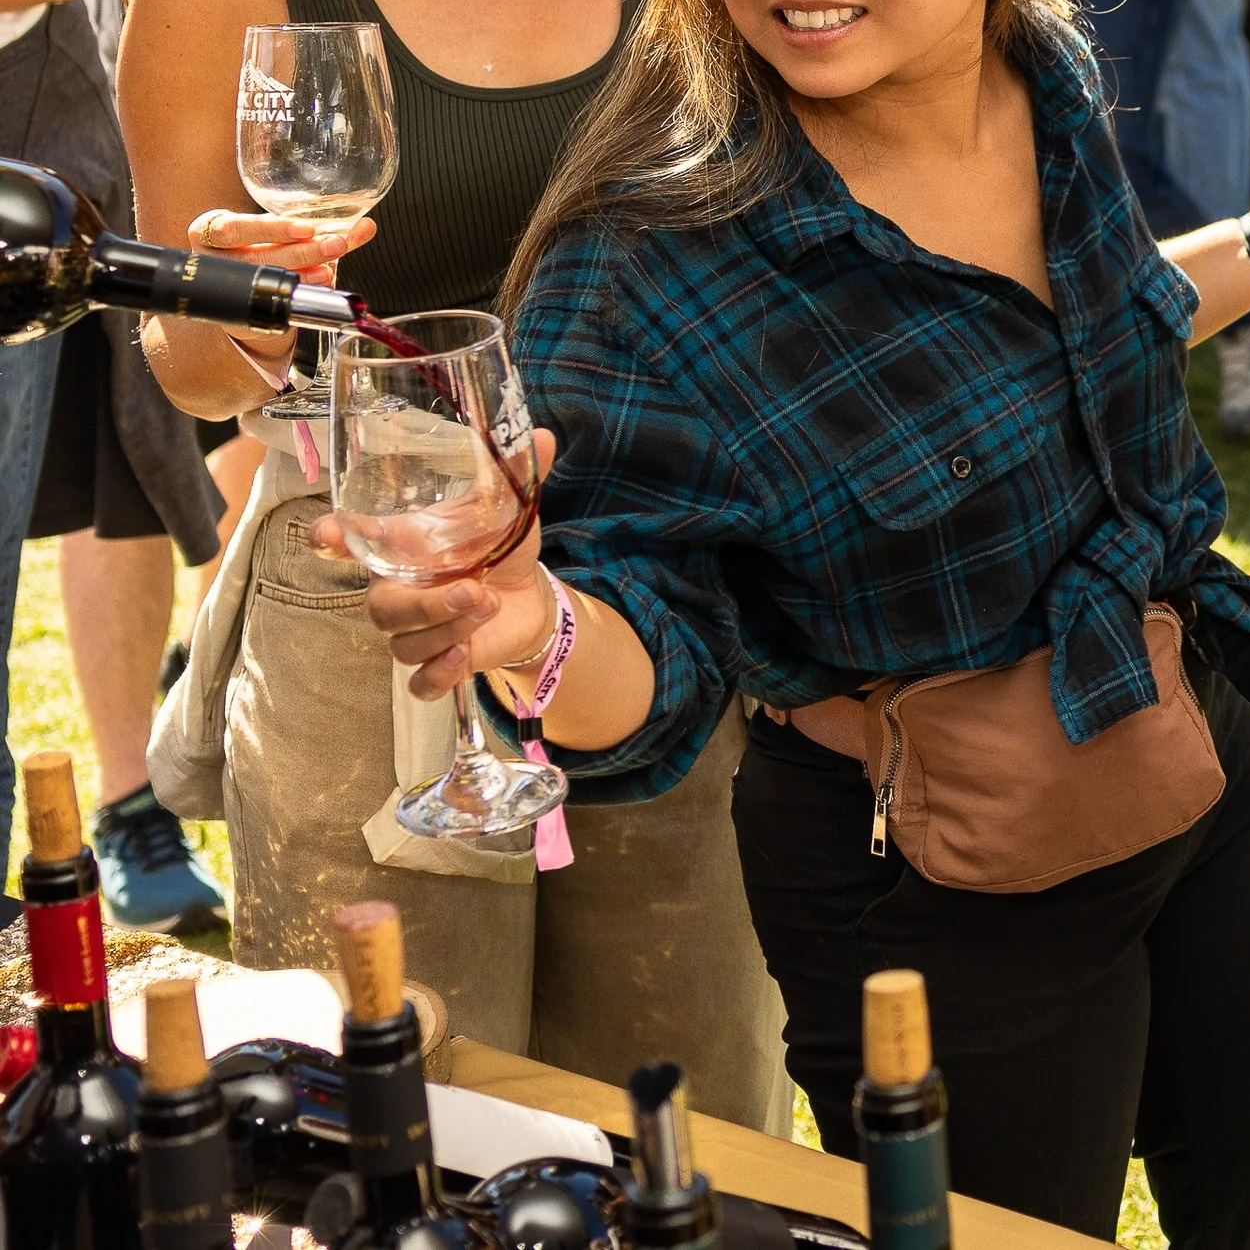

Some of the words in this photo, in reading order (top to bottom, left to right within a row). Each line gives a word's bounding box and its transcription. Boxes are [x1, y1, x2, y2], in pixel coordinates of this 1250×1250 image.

[253, 92, 296, 108] CITY
[555, 639, 572, 671] PARK
[536, 676, 557, 704] CITY
